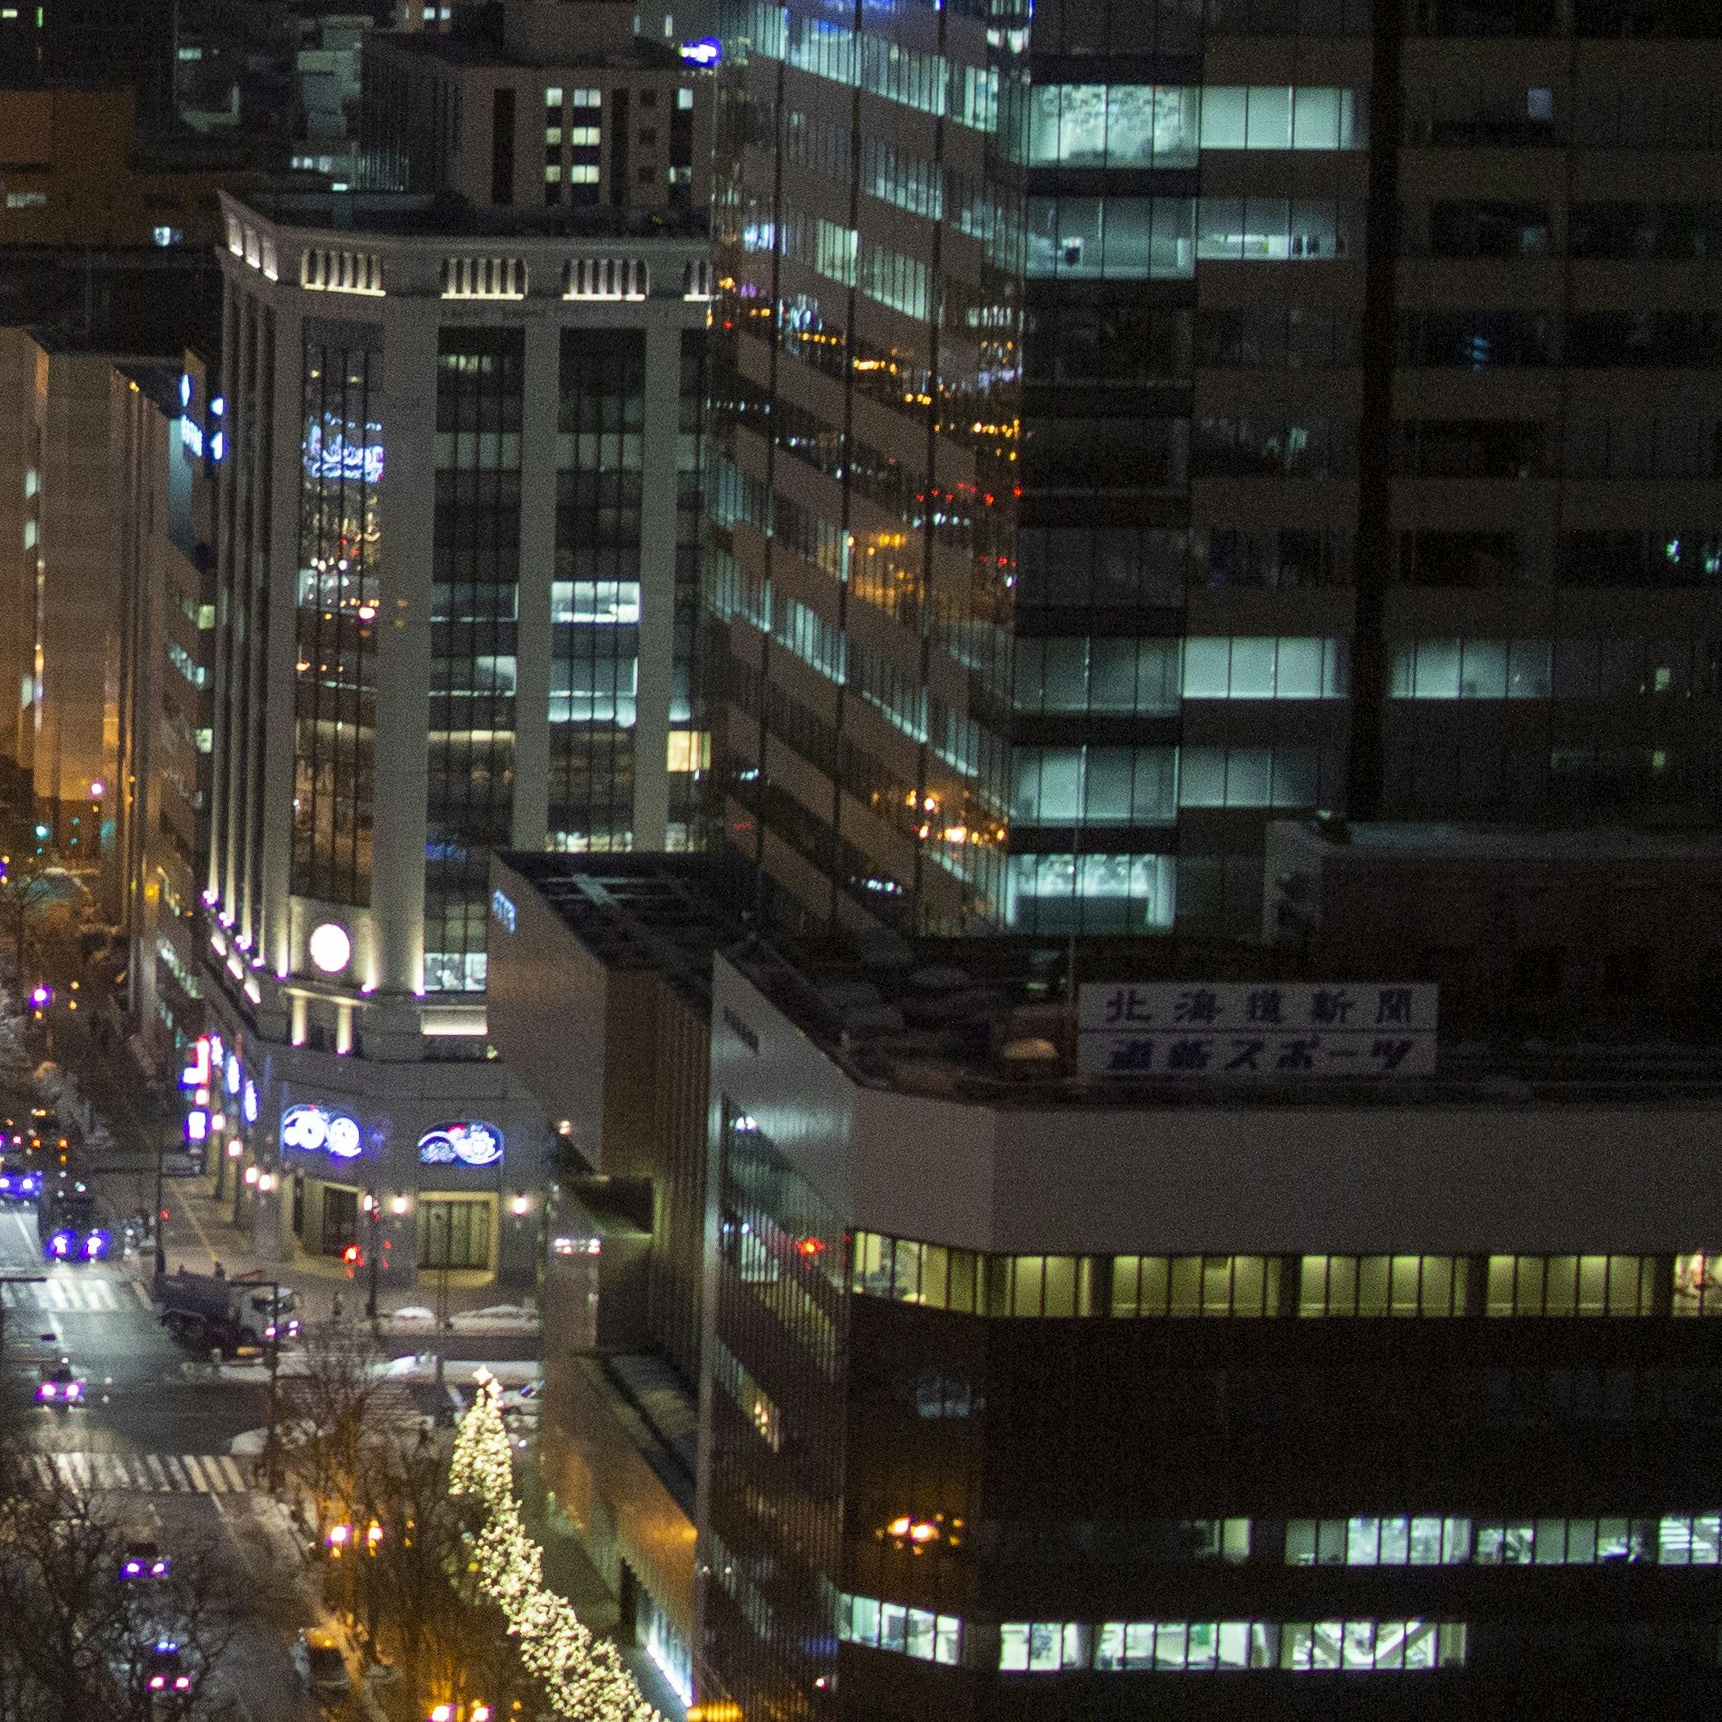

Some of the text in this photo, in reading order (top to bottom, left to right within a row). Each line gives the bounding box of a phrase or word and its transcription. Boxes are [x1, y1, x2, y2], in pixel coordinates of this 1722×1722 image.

[1106, 988, 1413, 1024] 北海道新聞
